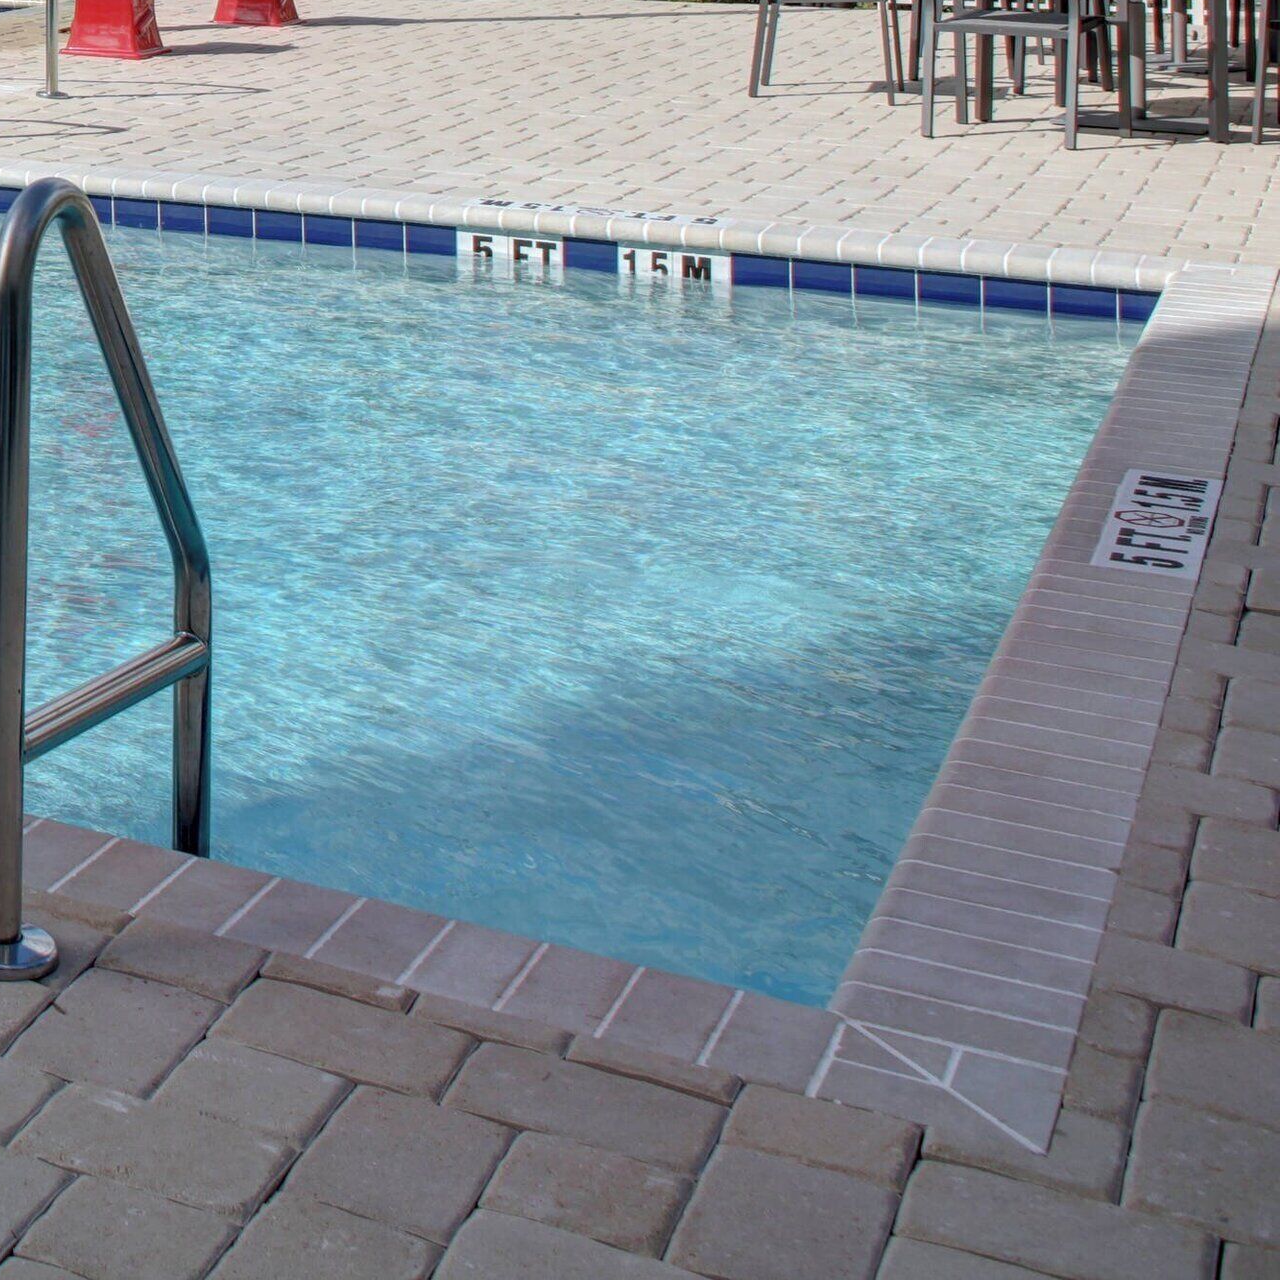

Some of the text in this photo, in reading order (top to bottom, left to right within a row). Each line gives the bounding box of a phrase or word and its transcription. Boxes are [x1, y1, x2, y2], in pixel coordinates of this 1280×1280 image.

[472, 235, 557, 266] 5 FT
[1130, 489, 1204, 512] 1.5
[1115, 527, 1192, 554] FT.
[1109, 552, 1184, 569] 5
